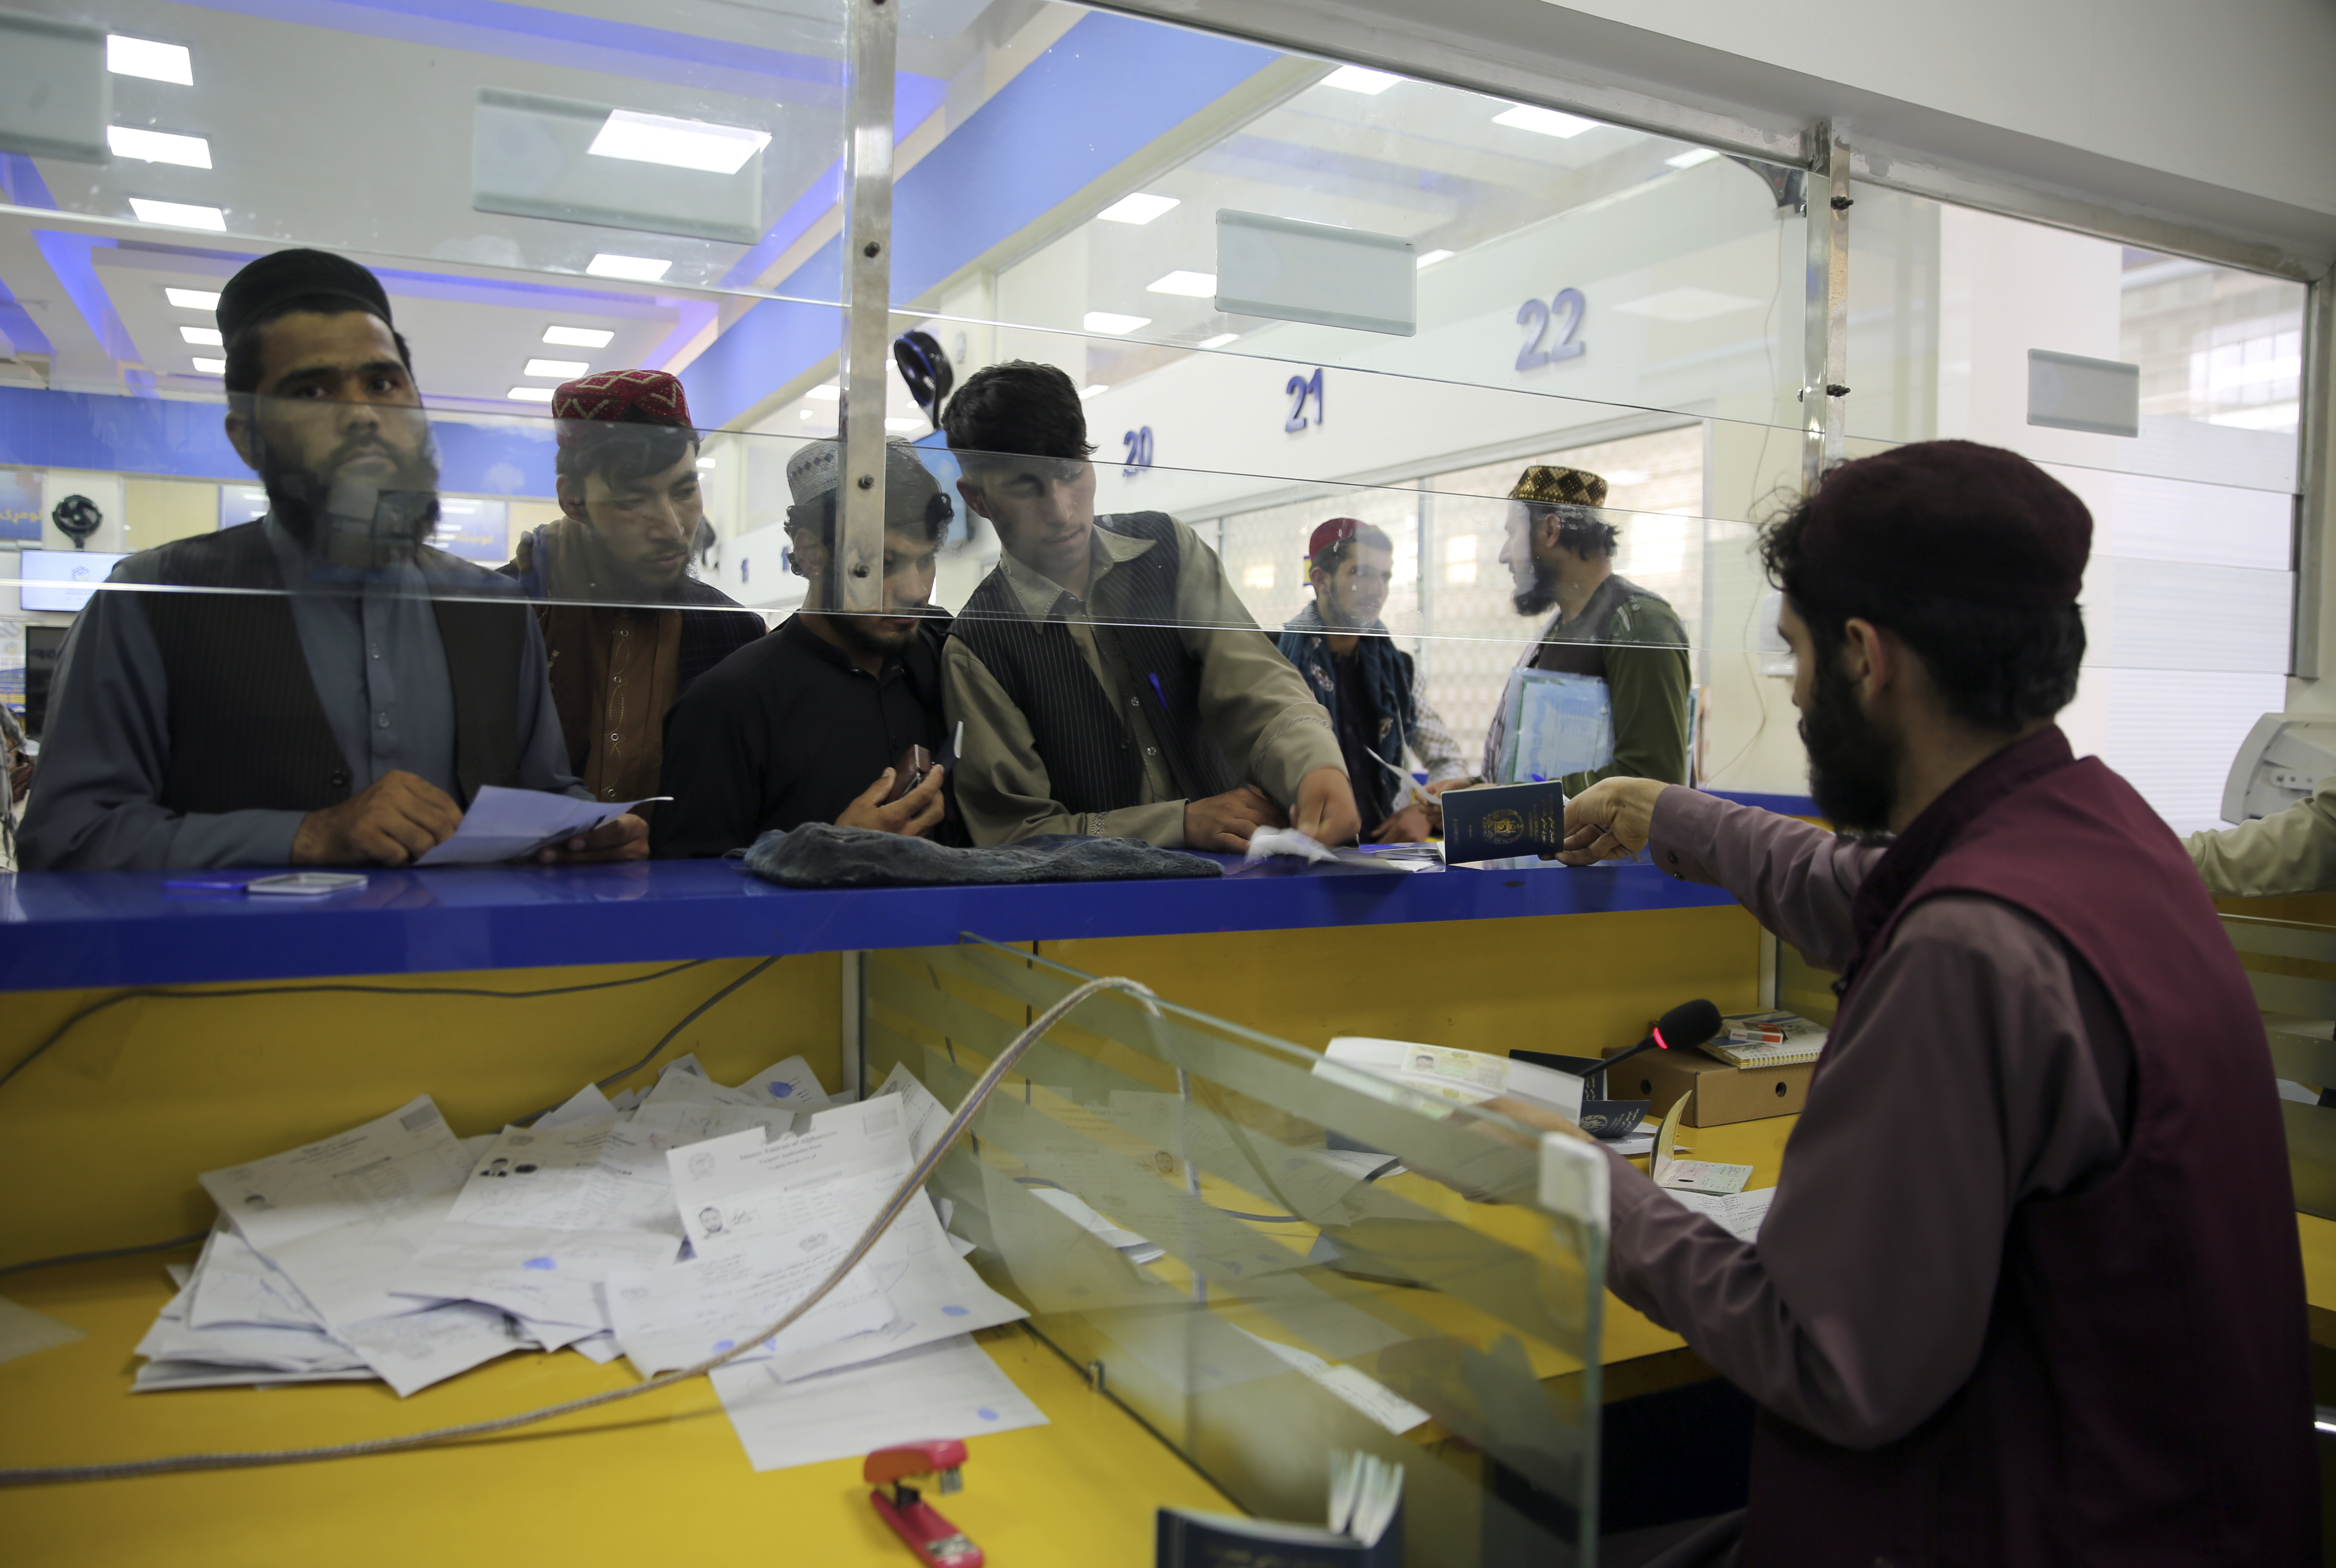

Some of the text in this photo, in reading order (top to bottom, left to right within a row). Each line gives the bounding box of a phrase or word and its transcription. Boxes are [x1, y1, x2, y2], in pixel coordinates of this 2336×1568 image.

[1516, 288, 1585, 371] 22
[1285, 368, 1323, 433] 21
[1123, 426, 1153, 477] 20
[740, 1151, 763, 1161] Islamic
[765, 1143, 790, 1154] Emirate
[801, 1131, 838, 1144] Afghanistan
